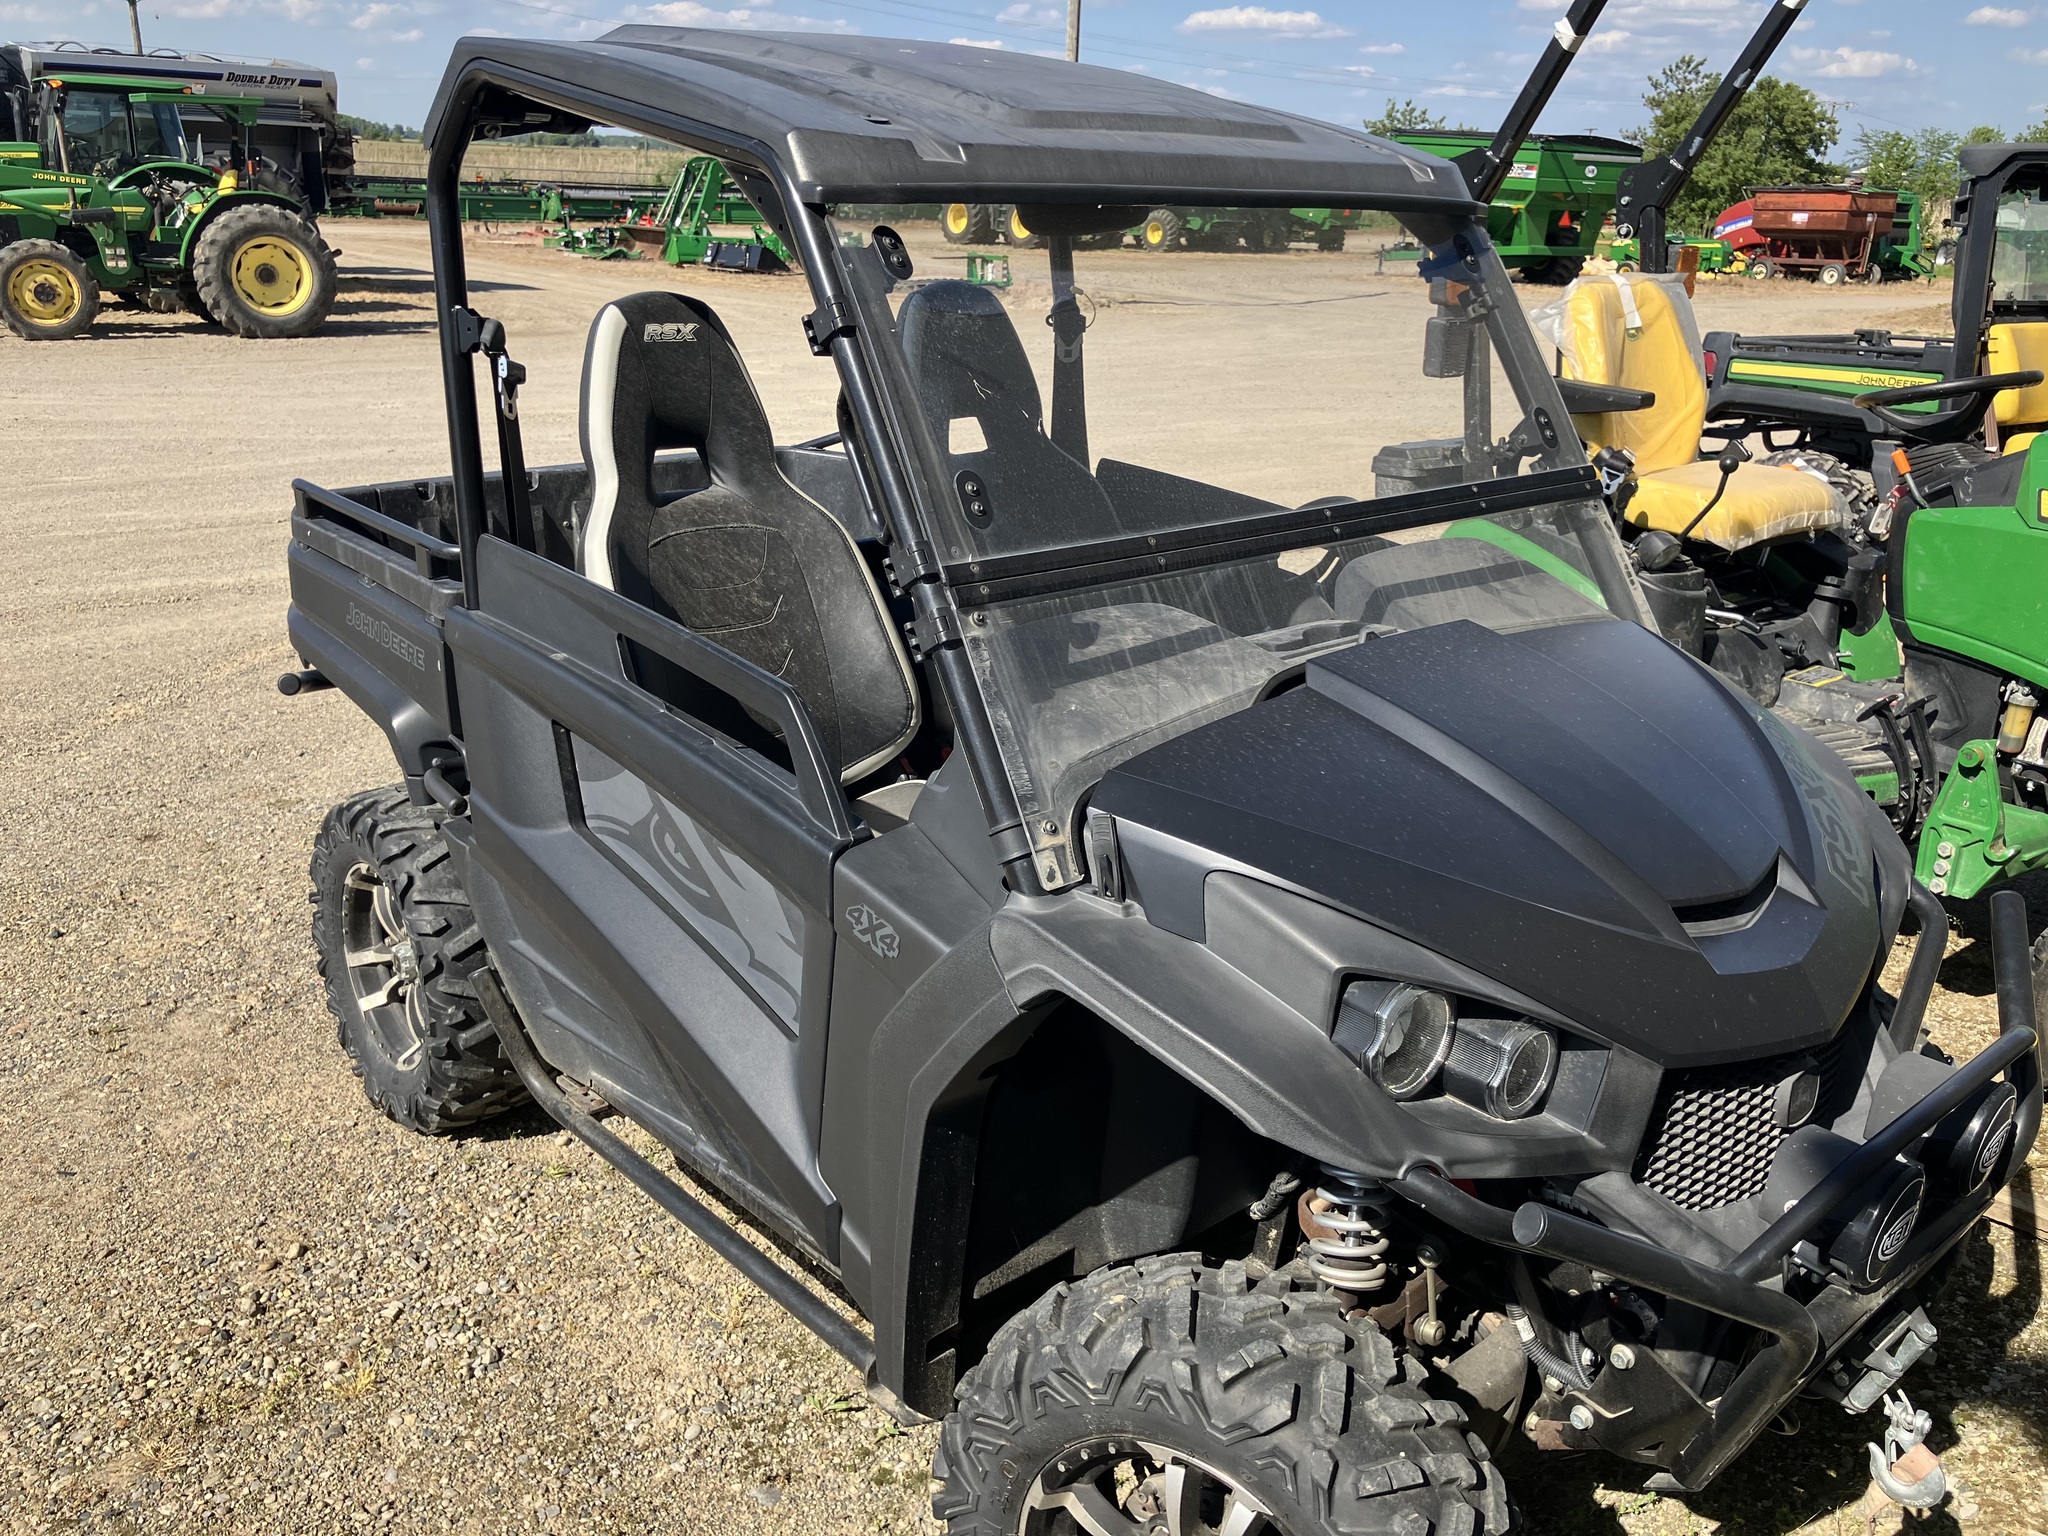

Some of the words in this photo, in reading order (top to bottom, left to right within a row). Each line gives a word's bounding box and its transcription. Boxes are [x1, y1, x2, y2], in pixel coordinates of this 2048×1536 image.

[225, 72, 267, 85] DOUBLE
[268, 74, 297, 87] DUTY
[32, 172, 56, 181] JOHN
[60, 175, 87, 185] DEERE
[643, 322, 700, 342] RSX
[1857, 374, 1884, 385] JOHN
[346, 602, 380, 642] JOHN
[381, 621, 425, 671] DEERE
